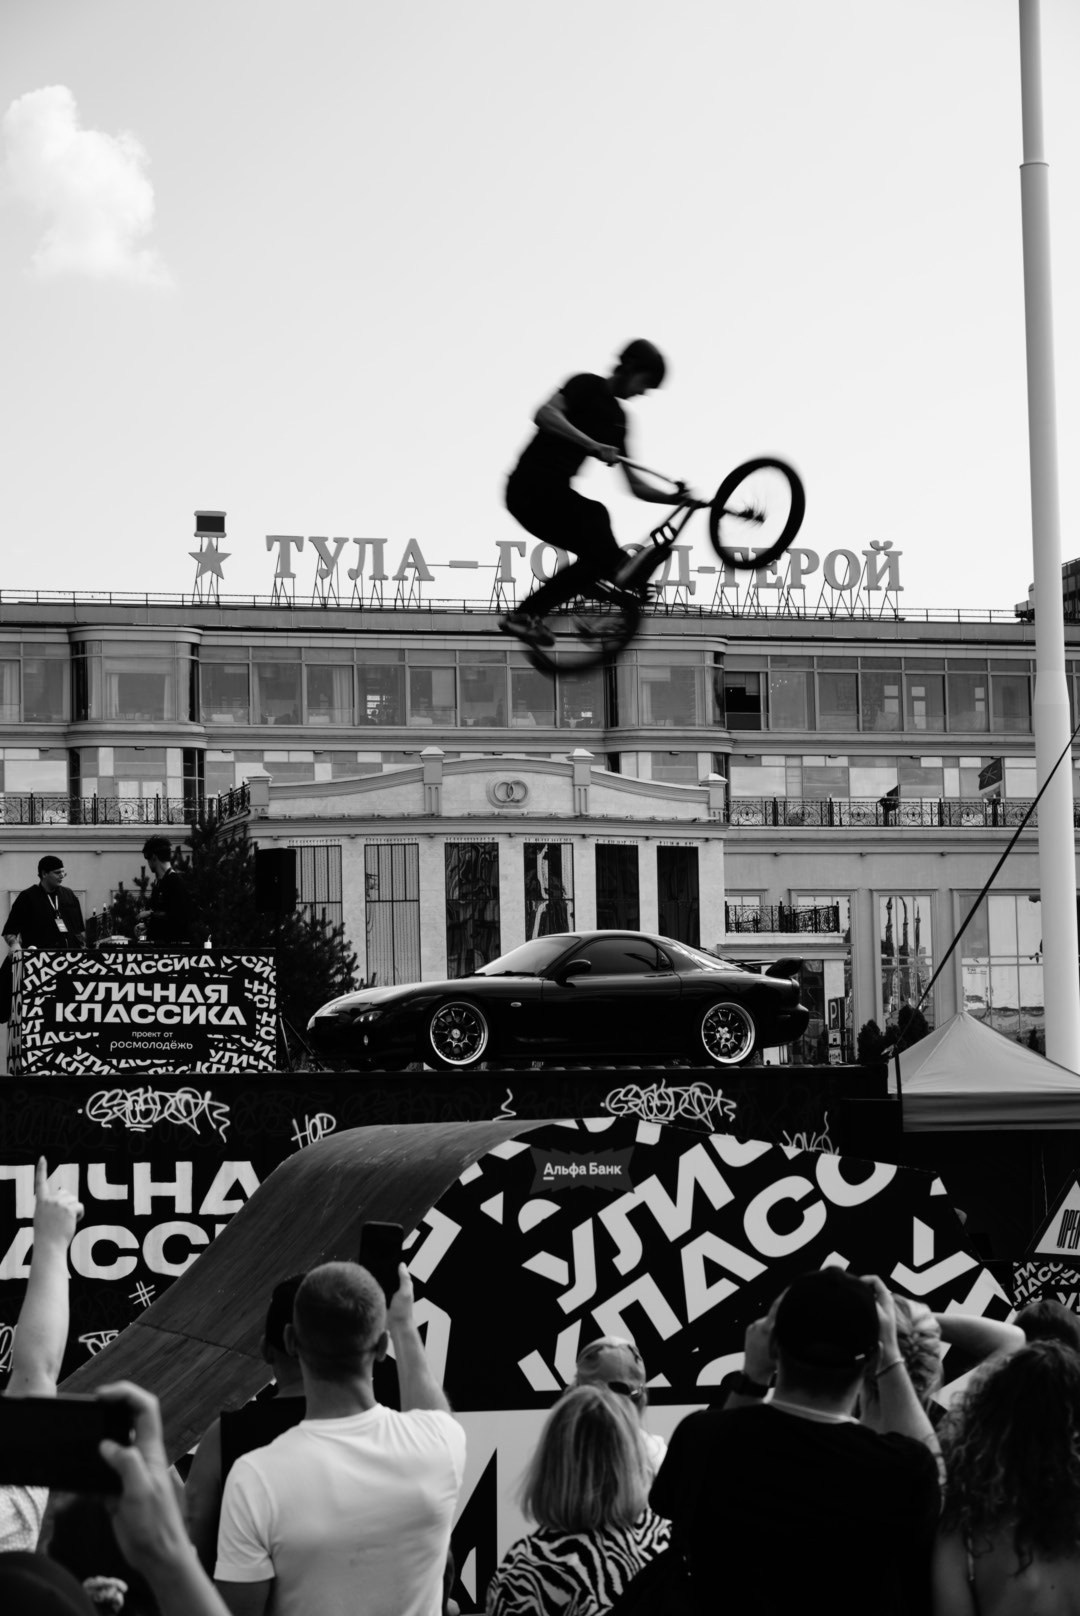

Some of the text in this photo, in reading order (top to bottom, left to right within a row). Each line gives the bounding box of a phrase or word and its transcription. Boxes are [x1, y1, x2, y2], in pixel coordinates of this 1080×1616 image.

[266, 535, 435, 581] ТУЛА
[72, 981, 229, 1004] УЛИЧНАЯ
[55, 1002, 248, 1026] КЛАССИКА
[131, 1031, 161, 1039] проект
[109, 1040, 194, 1052] росмолодёжь
[543, 1162, 623, 1181] Альфа Банк
